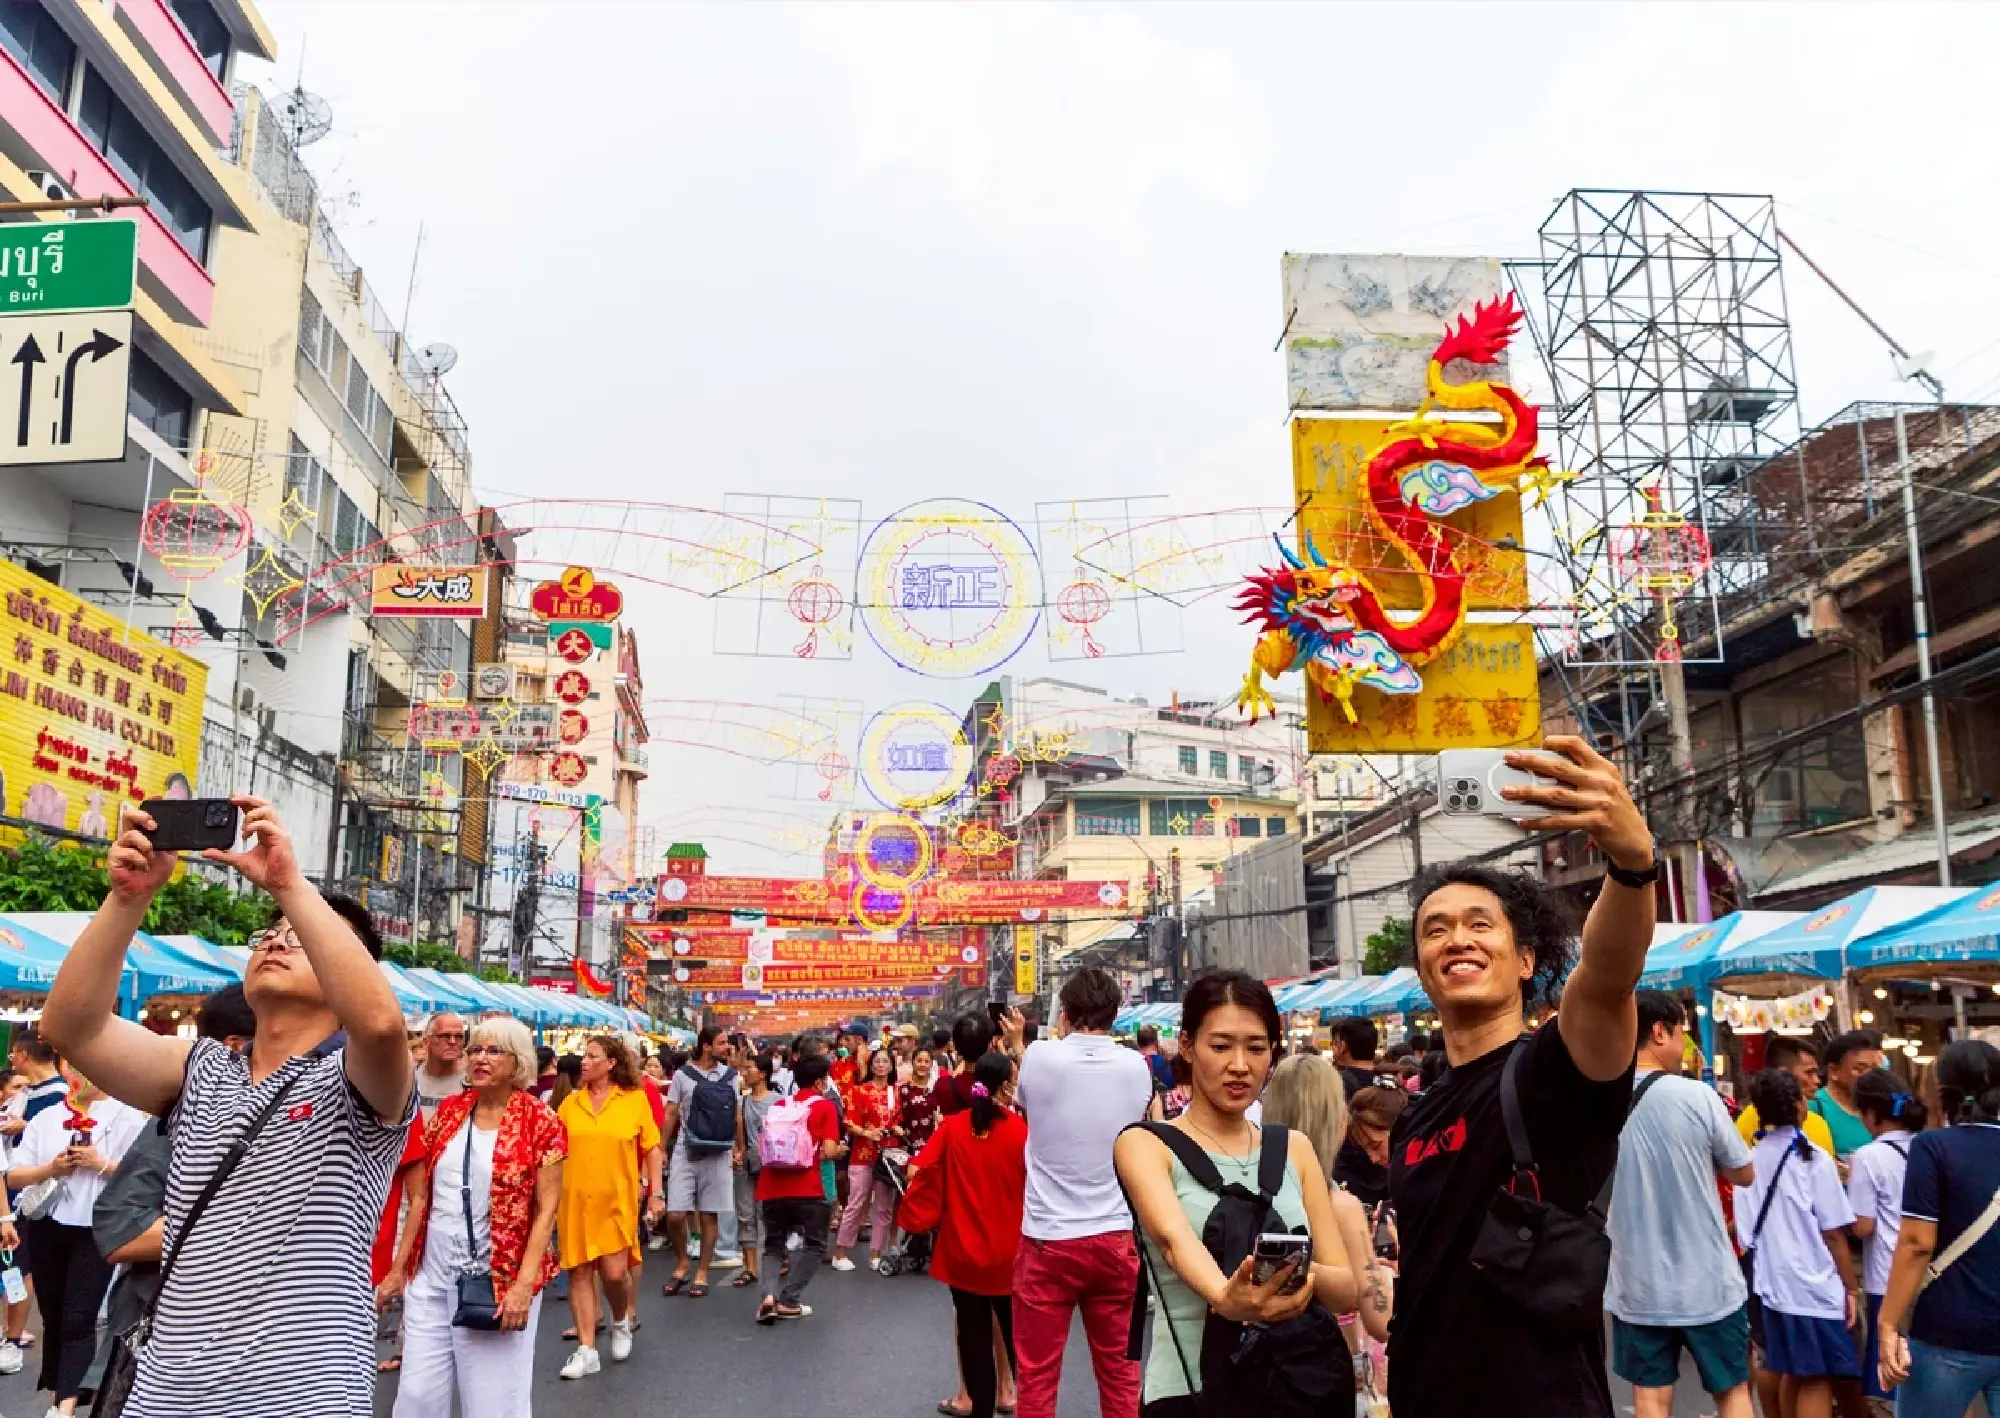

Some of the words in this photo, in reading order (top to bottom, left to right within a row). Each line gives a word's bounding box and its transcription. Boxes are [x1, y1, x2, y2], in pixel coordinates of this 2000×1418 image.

[9, 289, 44, 303] Buri
[416, 573, 472, 602] 大成
[902, 563, 1000, 610] 新正
[0, 667, 28, 700] LIM
[34, 682, 88, 723] HIANG
[93, 707, 115, 734] HA
[887, 740, 949, 771] 如意
